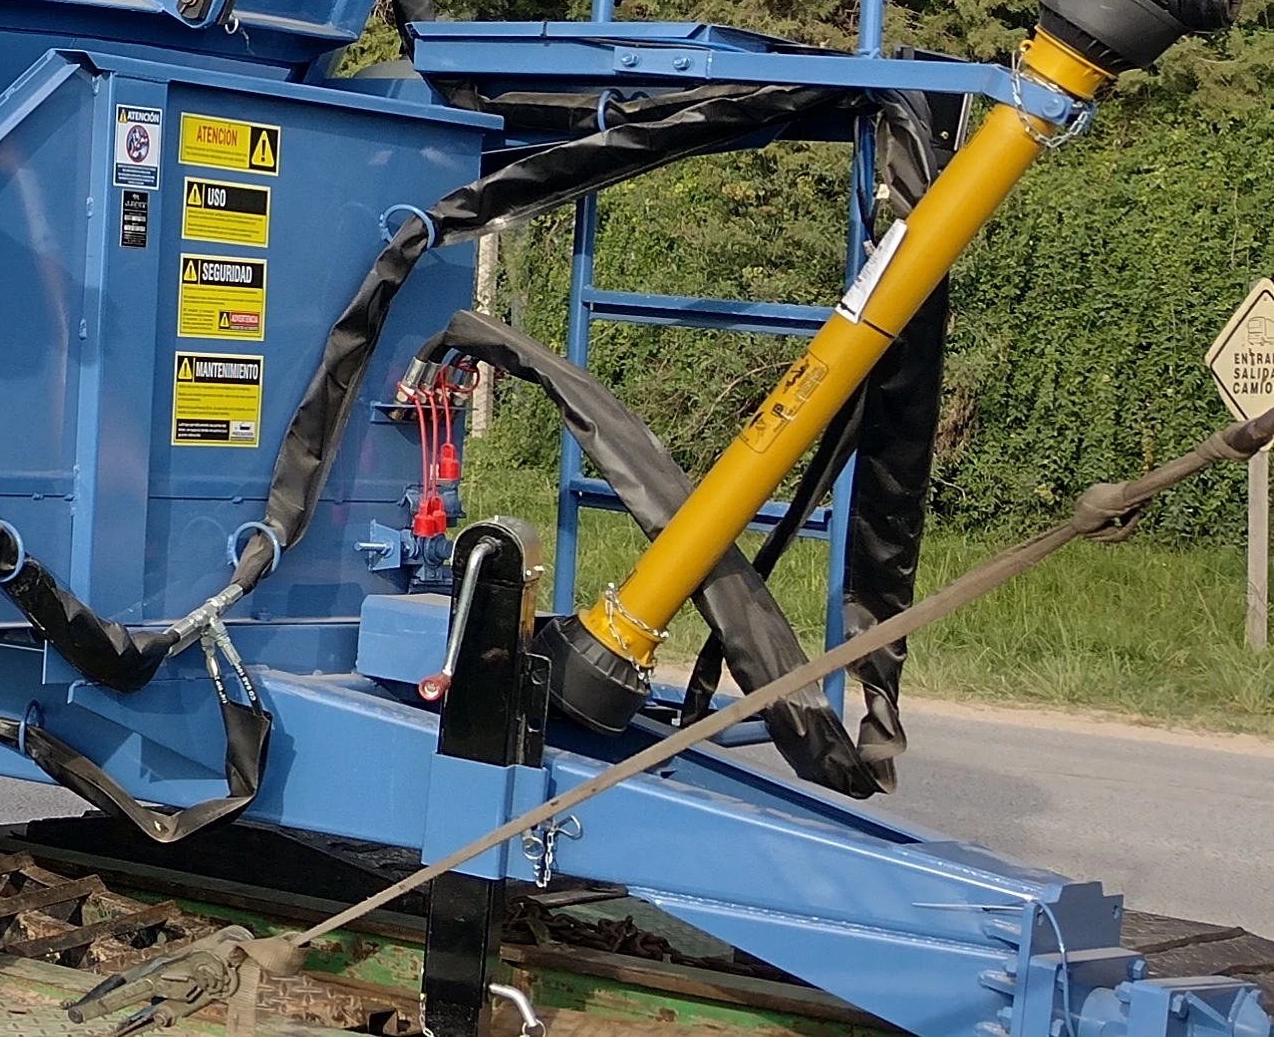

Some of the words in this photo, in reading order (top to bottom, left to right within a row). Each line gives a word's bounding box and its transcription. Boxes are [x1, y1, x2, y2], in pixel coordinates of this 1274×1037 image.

[127, 112, 160, 123] ATENCIÓN
[196, 124, 238, 147] ATENCIÓN
[207, 187, 227, 208] USO
[202, 263, 253, 284] SEGURIDAD
[1234, 352, 1274, 365] ENTRA
[195, 361, 259, 380] MANTENIMIENTO
